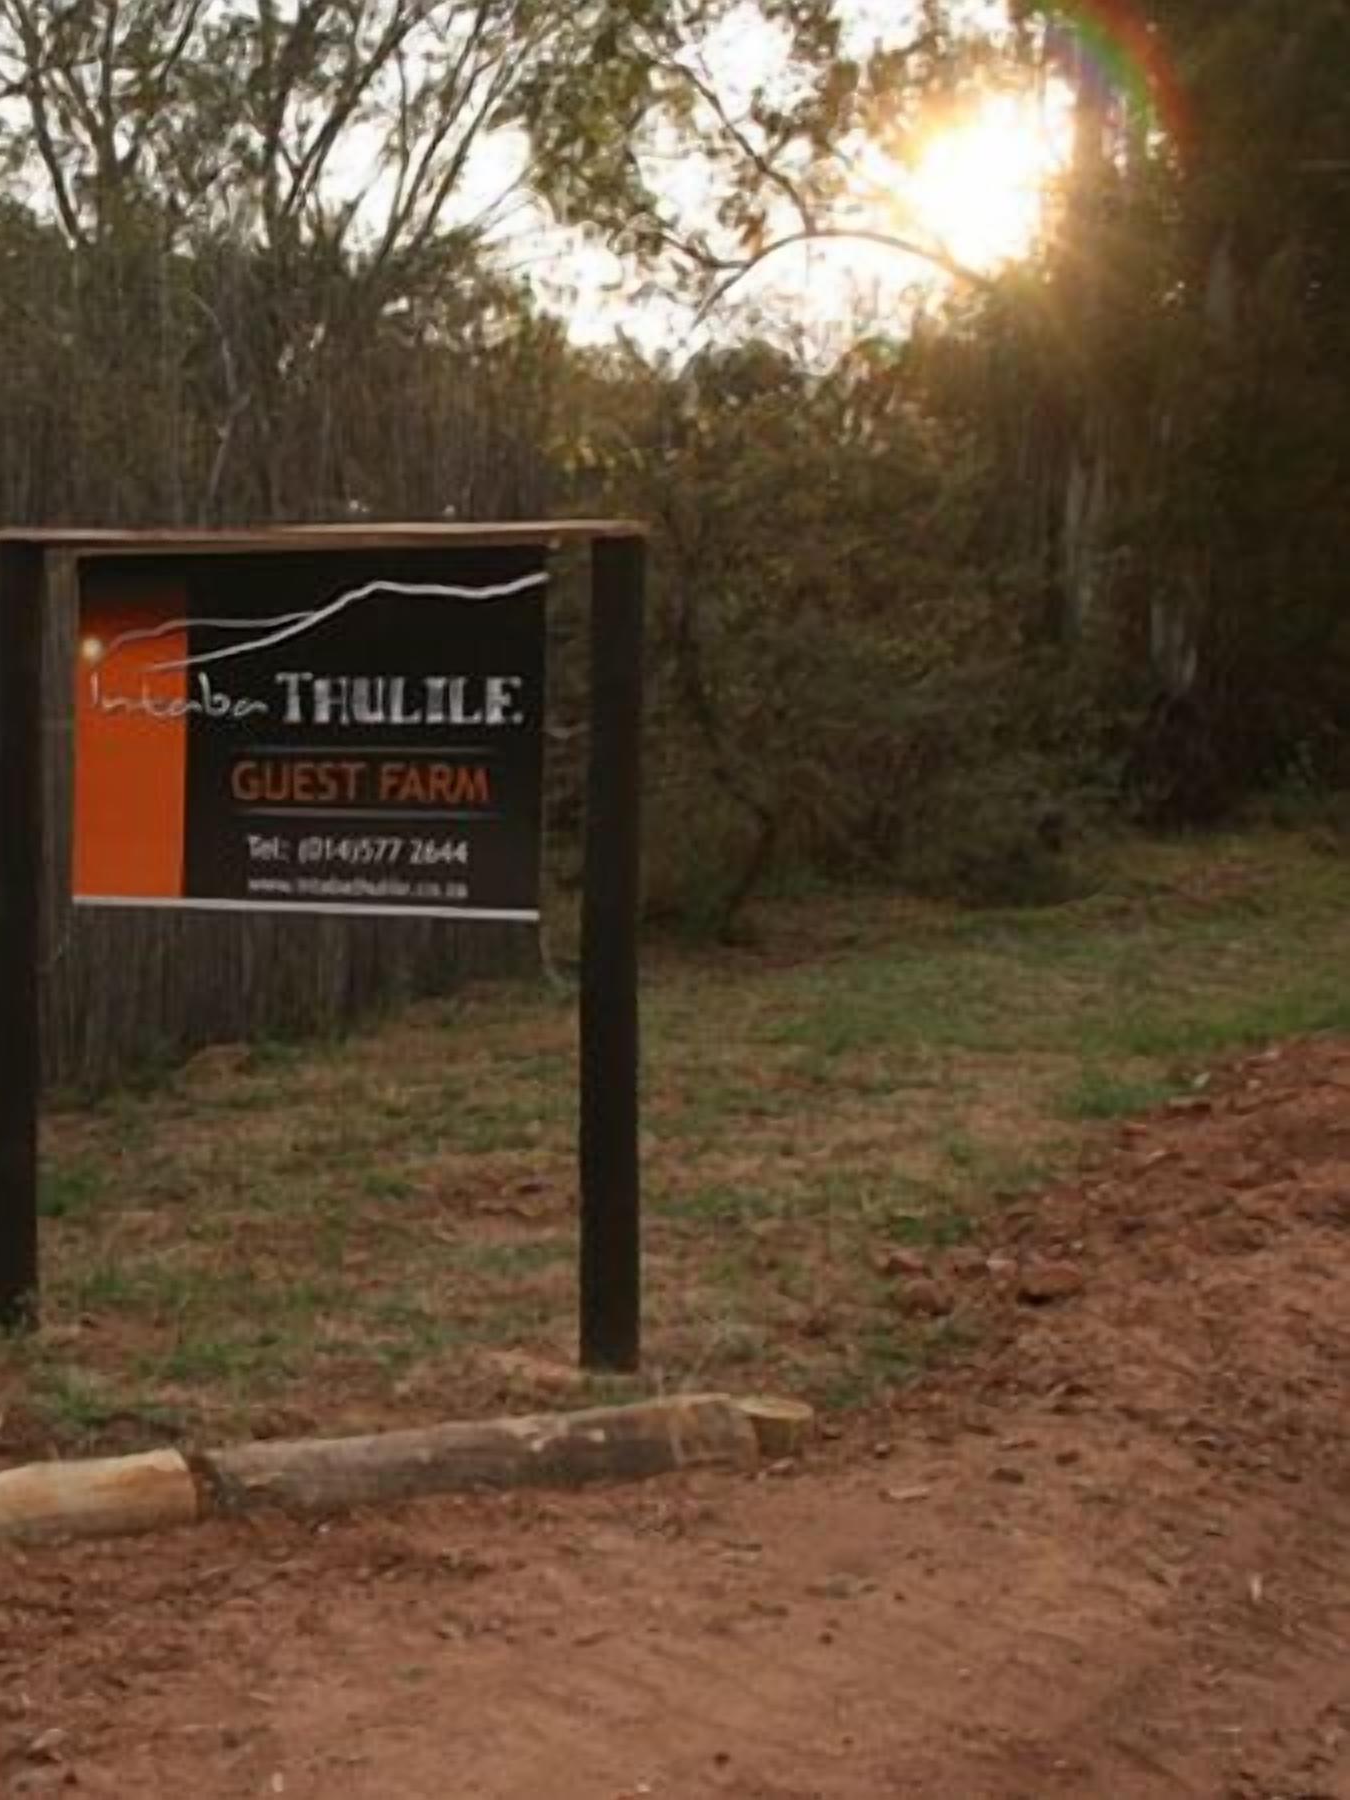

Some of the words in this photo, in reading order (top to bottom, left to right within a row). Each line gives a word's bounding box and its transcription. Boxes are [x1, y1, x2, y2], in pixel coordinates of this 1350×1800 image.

[275, 672, 523, 725] THULILE
[230, 760, 366, 801] GUEST
[379, 762, 491, 803] FARM
